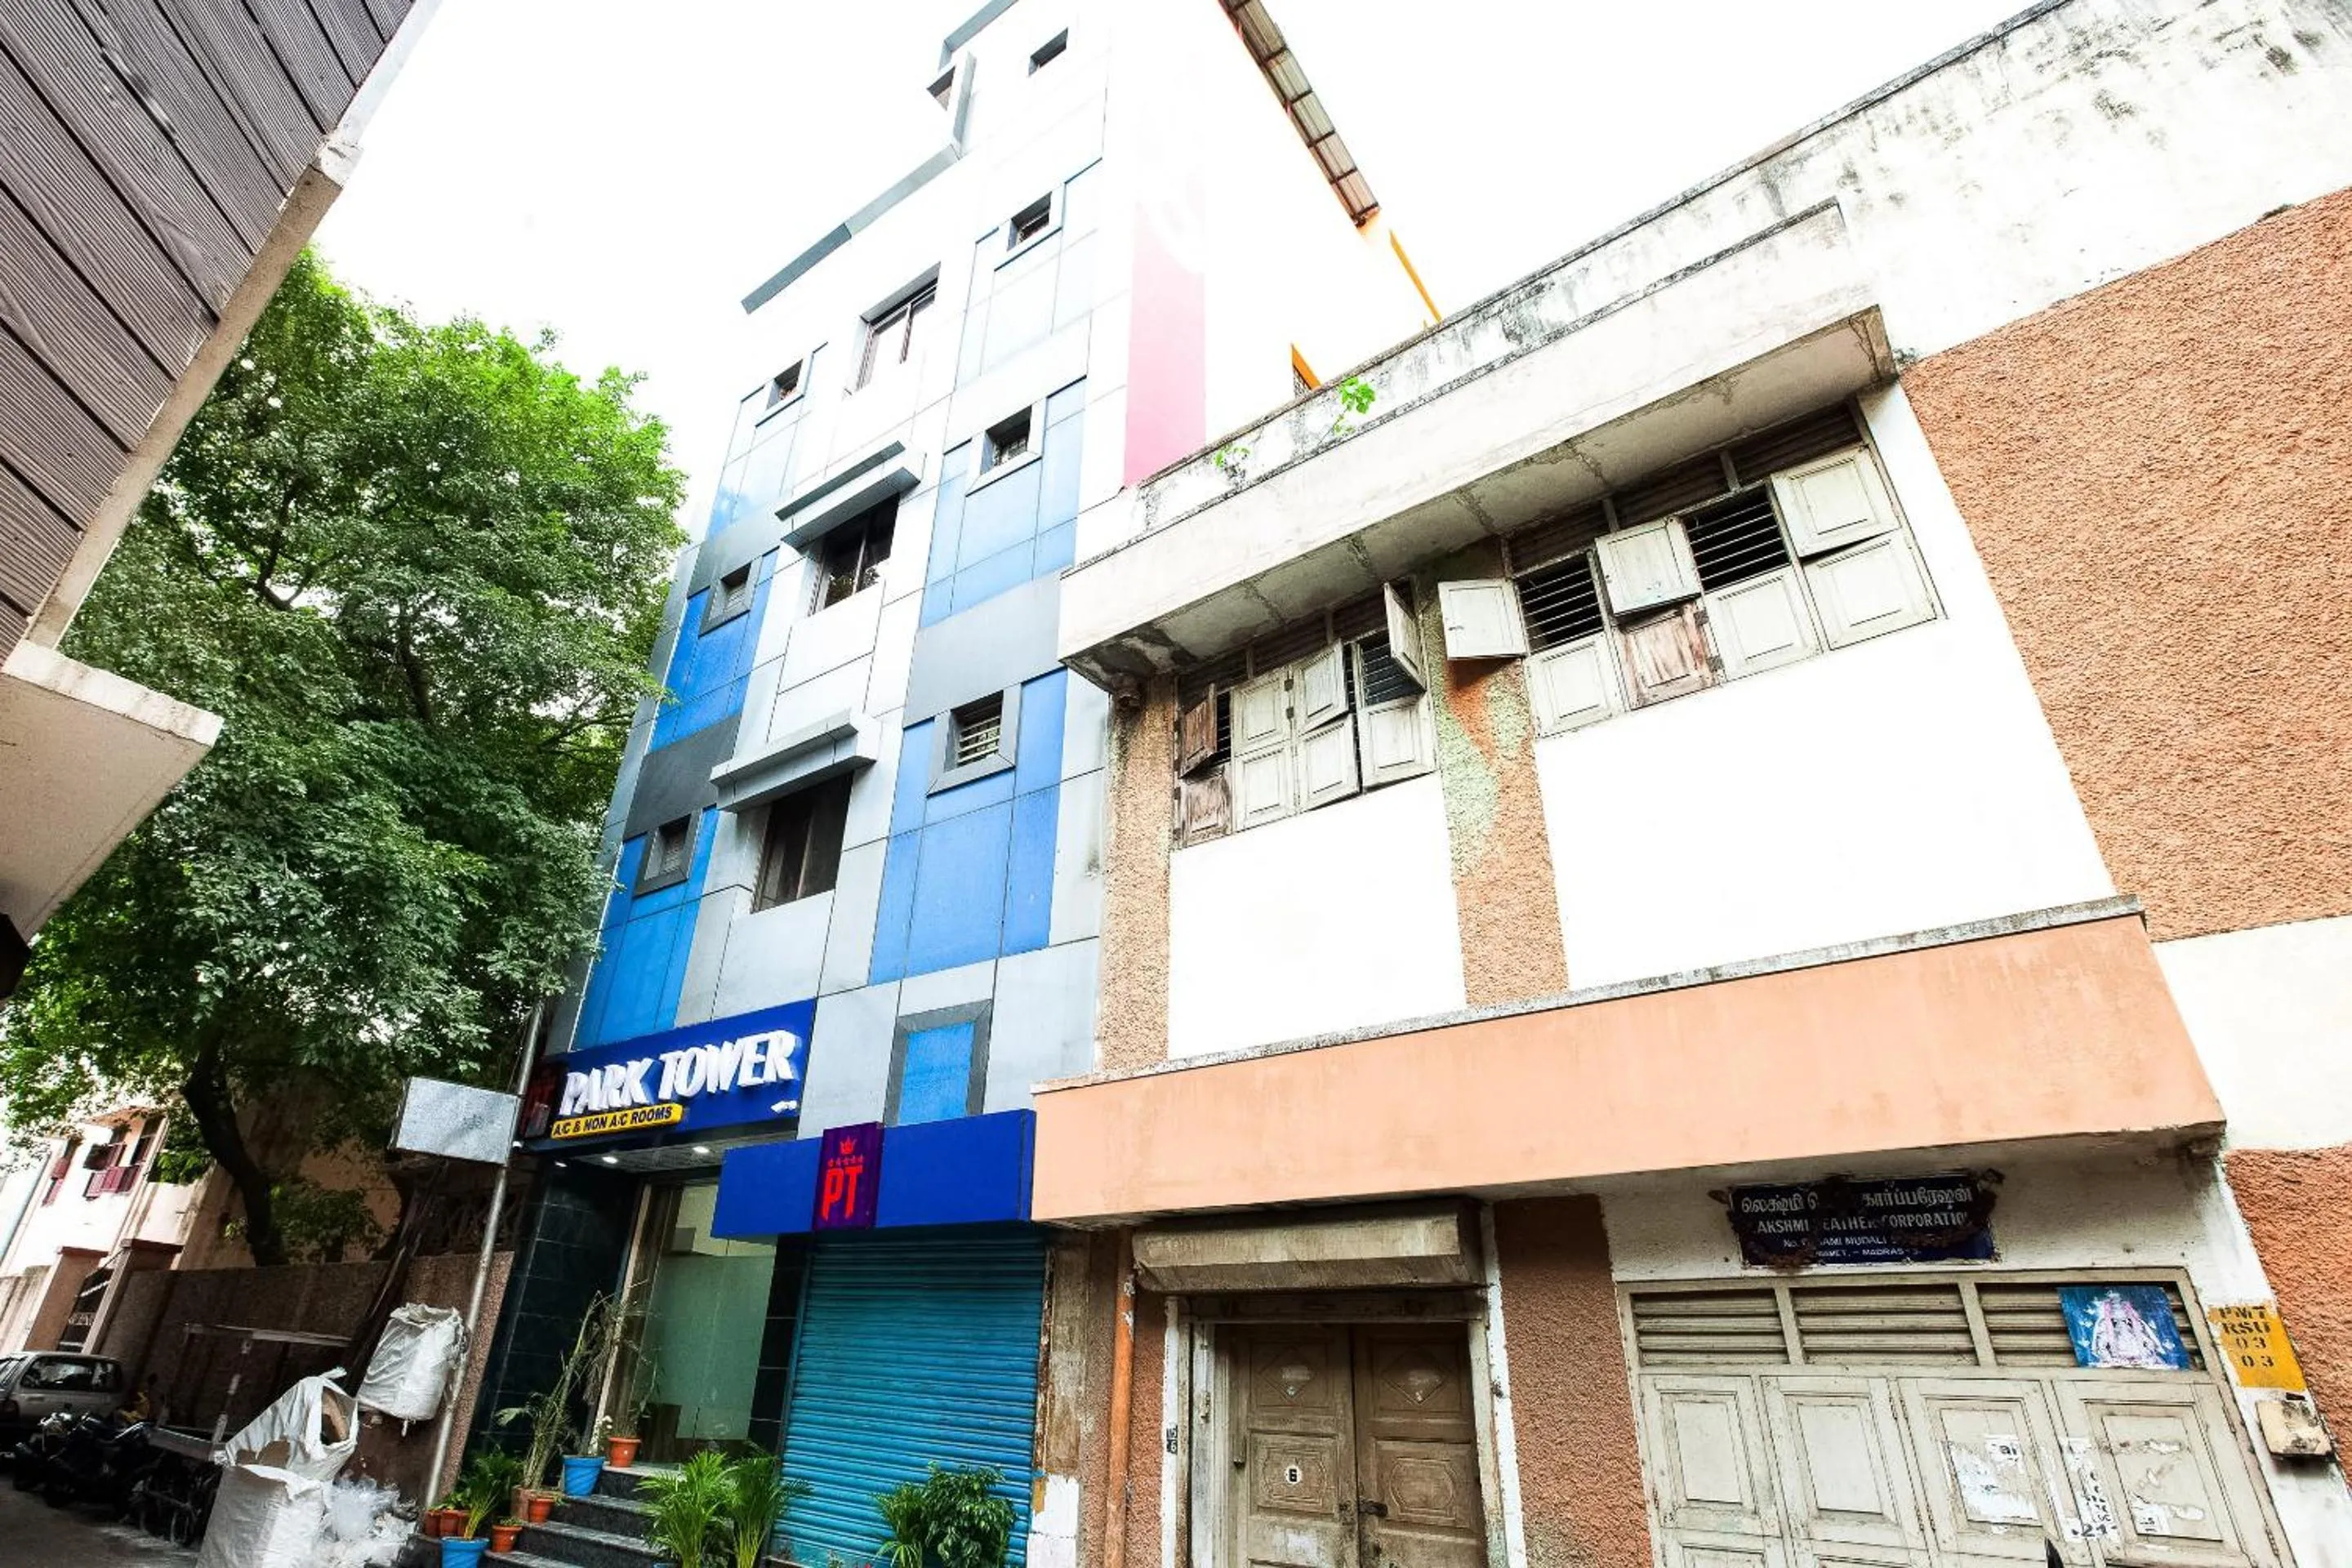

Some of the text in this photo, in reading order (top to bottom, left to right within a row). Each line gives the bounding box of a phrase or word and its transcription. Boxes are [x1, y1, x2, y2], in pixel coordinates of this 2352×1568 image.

[559, 1030, 799, 1116] PARK TOWER
[573, 1120, 582, 1132] &
[584, 1115, 608, 1131] NON
[630, 1106, 674, 1125] ROOMS
[822, 1165, 863, 1221] PT
[2221, 1321, 2271, 1334] RSU
[2235, 1337, 2266, 1349] 03
[2241, 1355, 2274, 1367] 03
[1289, 1468, 1298, 1482] 6
